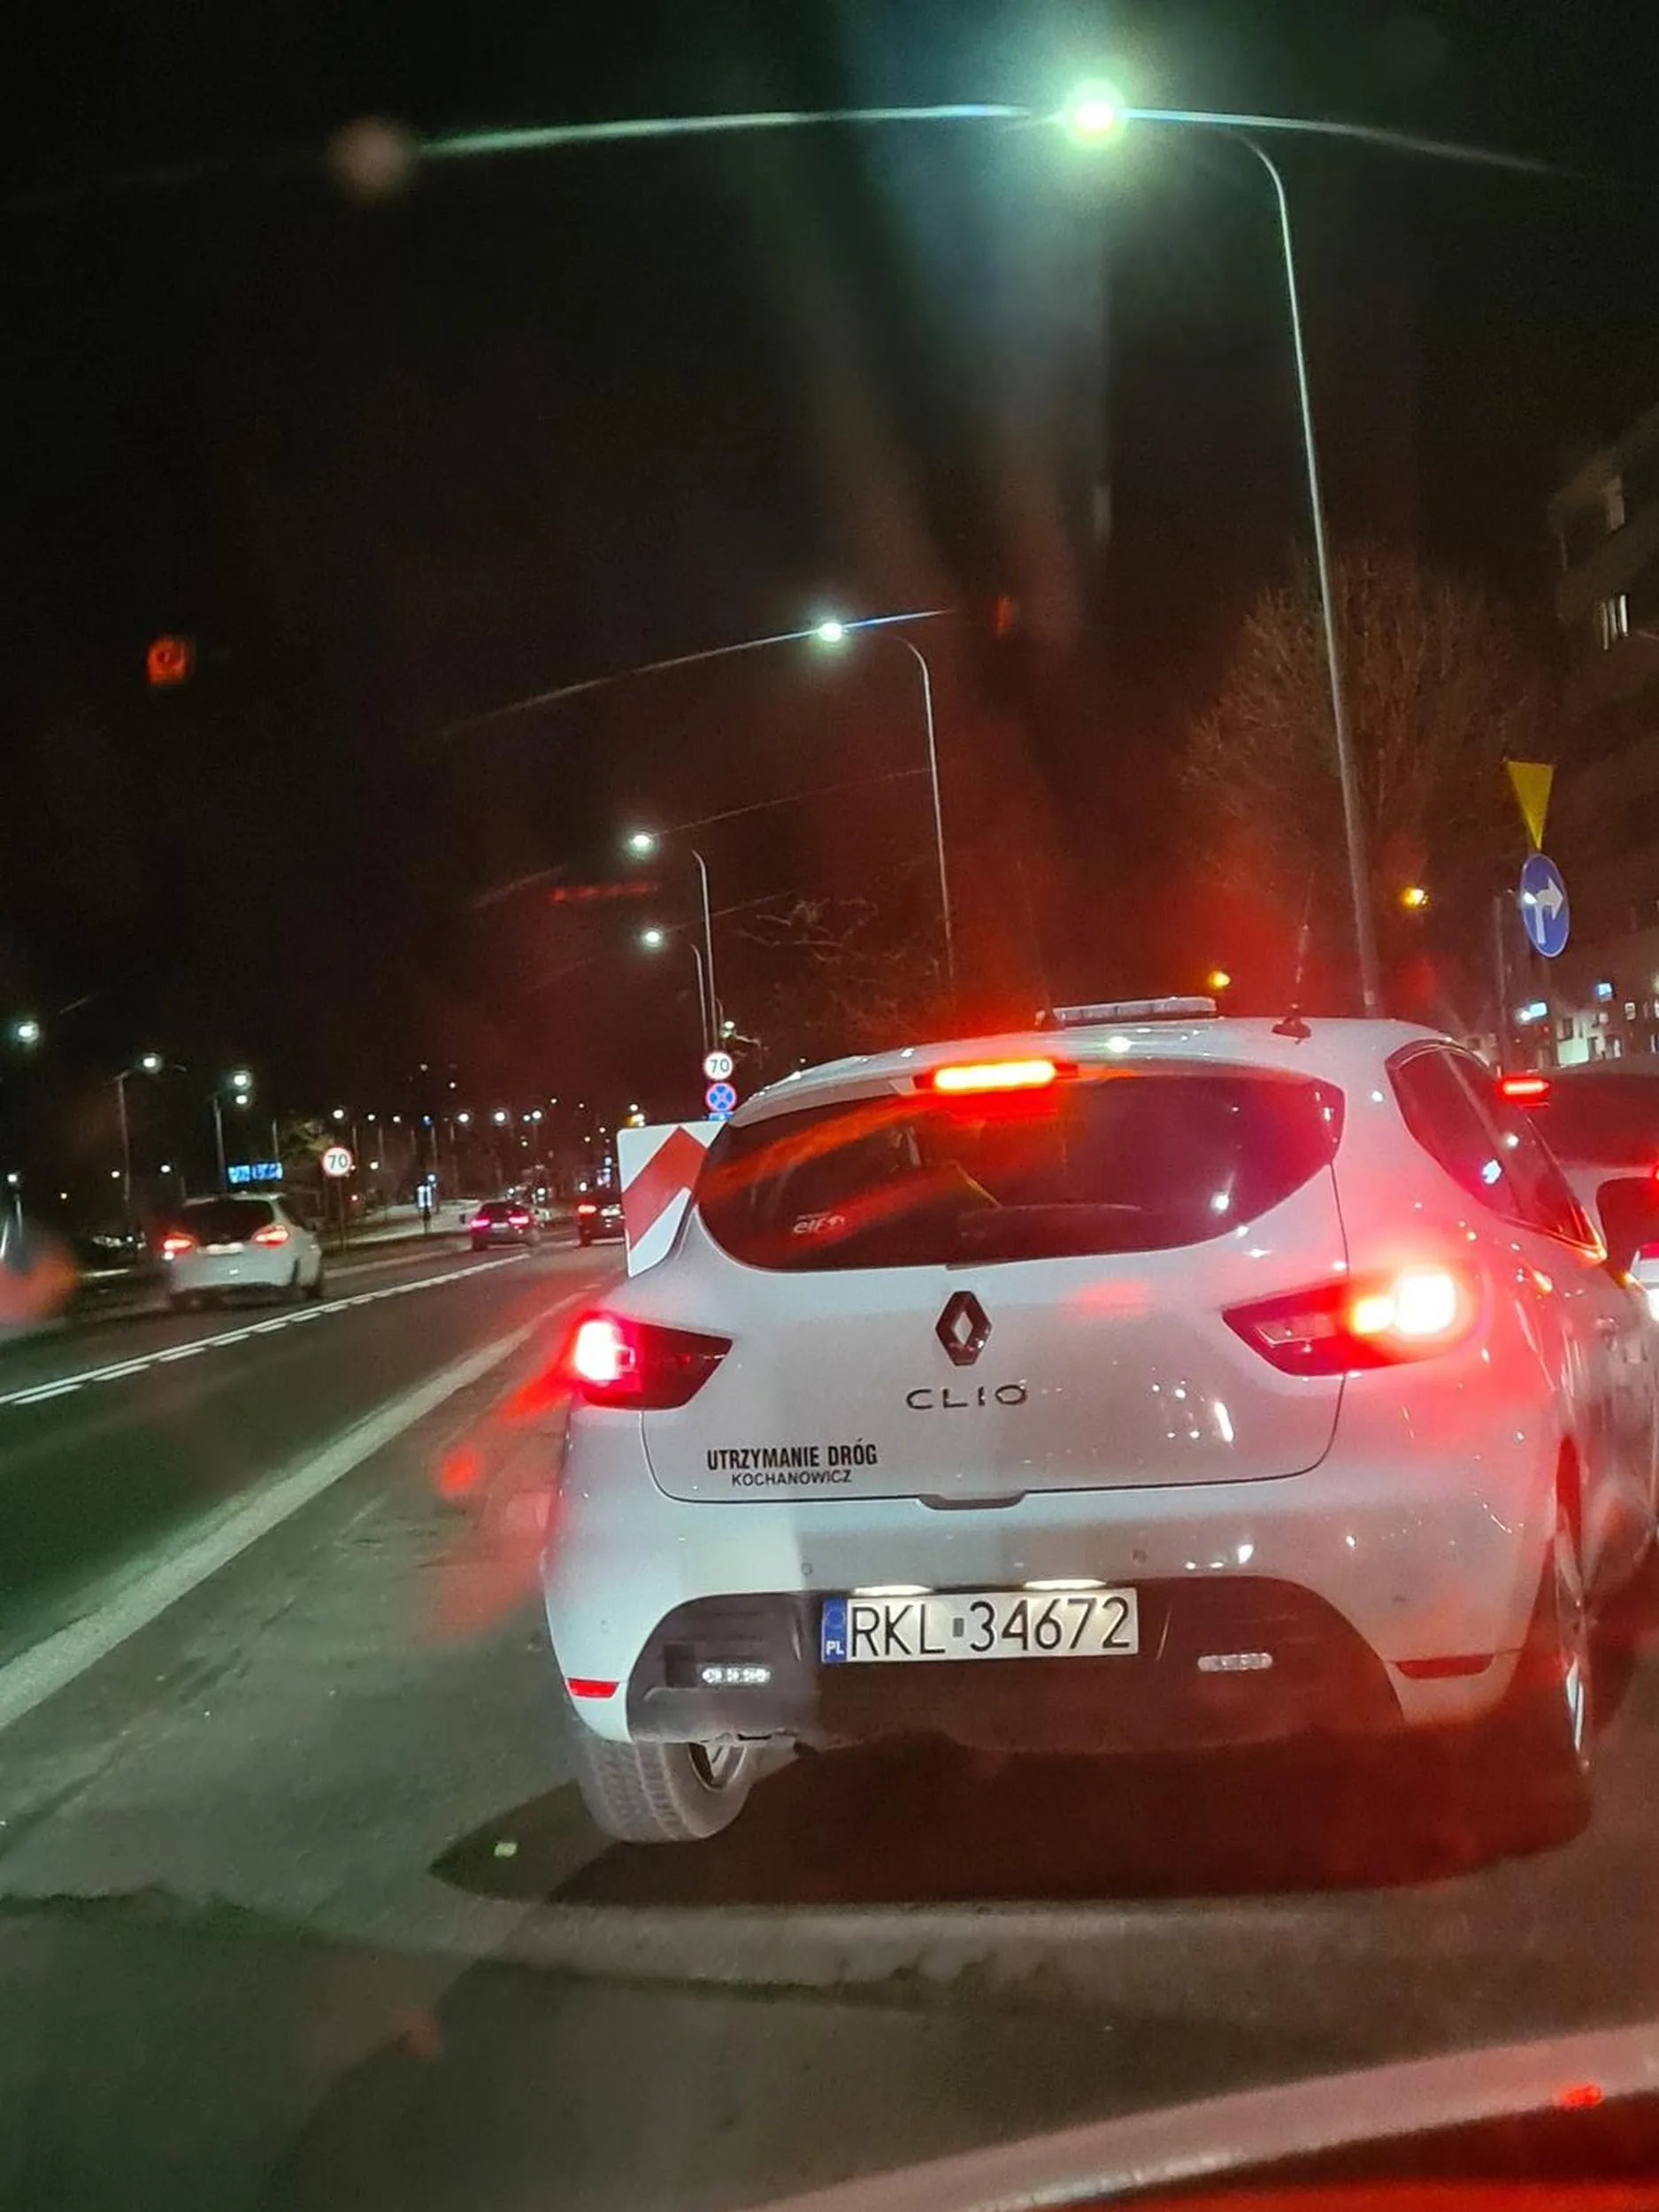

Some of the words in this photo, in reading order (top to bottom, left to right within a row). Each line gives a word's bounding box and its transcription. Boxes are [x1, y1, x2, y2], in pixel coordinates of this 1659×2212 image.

[710, 1058, 730, 1073] 70
[327, 1153, 348, 1169] 70
[906, 1384, 1028, 1410] CLIO
[707, 1446, 819, 1471] UTRZYMANIE
[828, 1438, 878, 1467] DRÓG
[731, 1469, 853, 1487] KOCHANOWICZ
[850, 1602, 946, 1657] RKL
[969, 1595, 1131, 1653] 34672
[826, 1640, 845, 1655] PL
